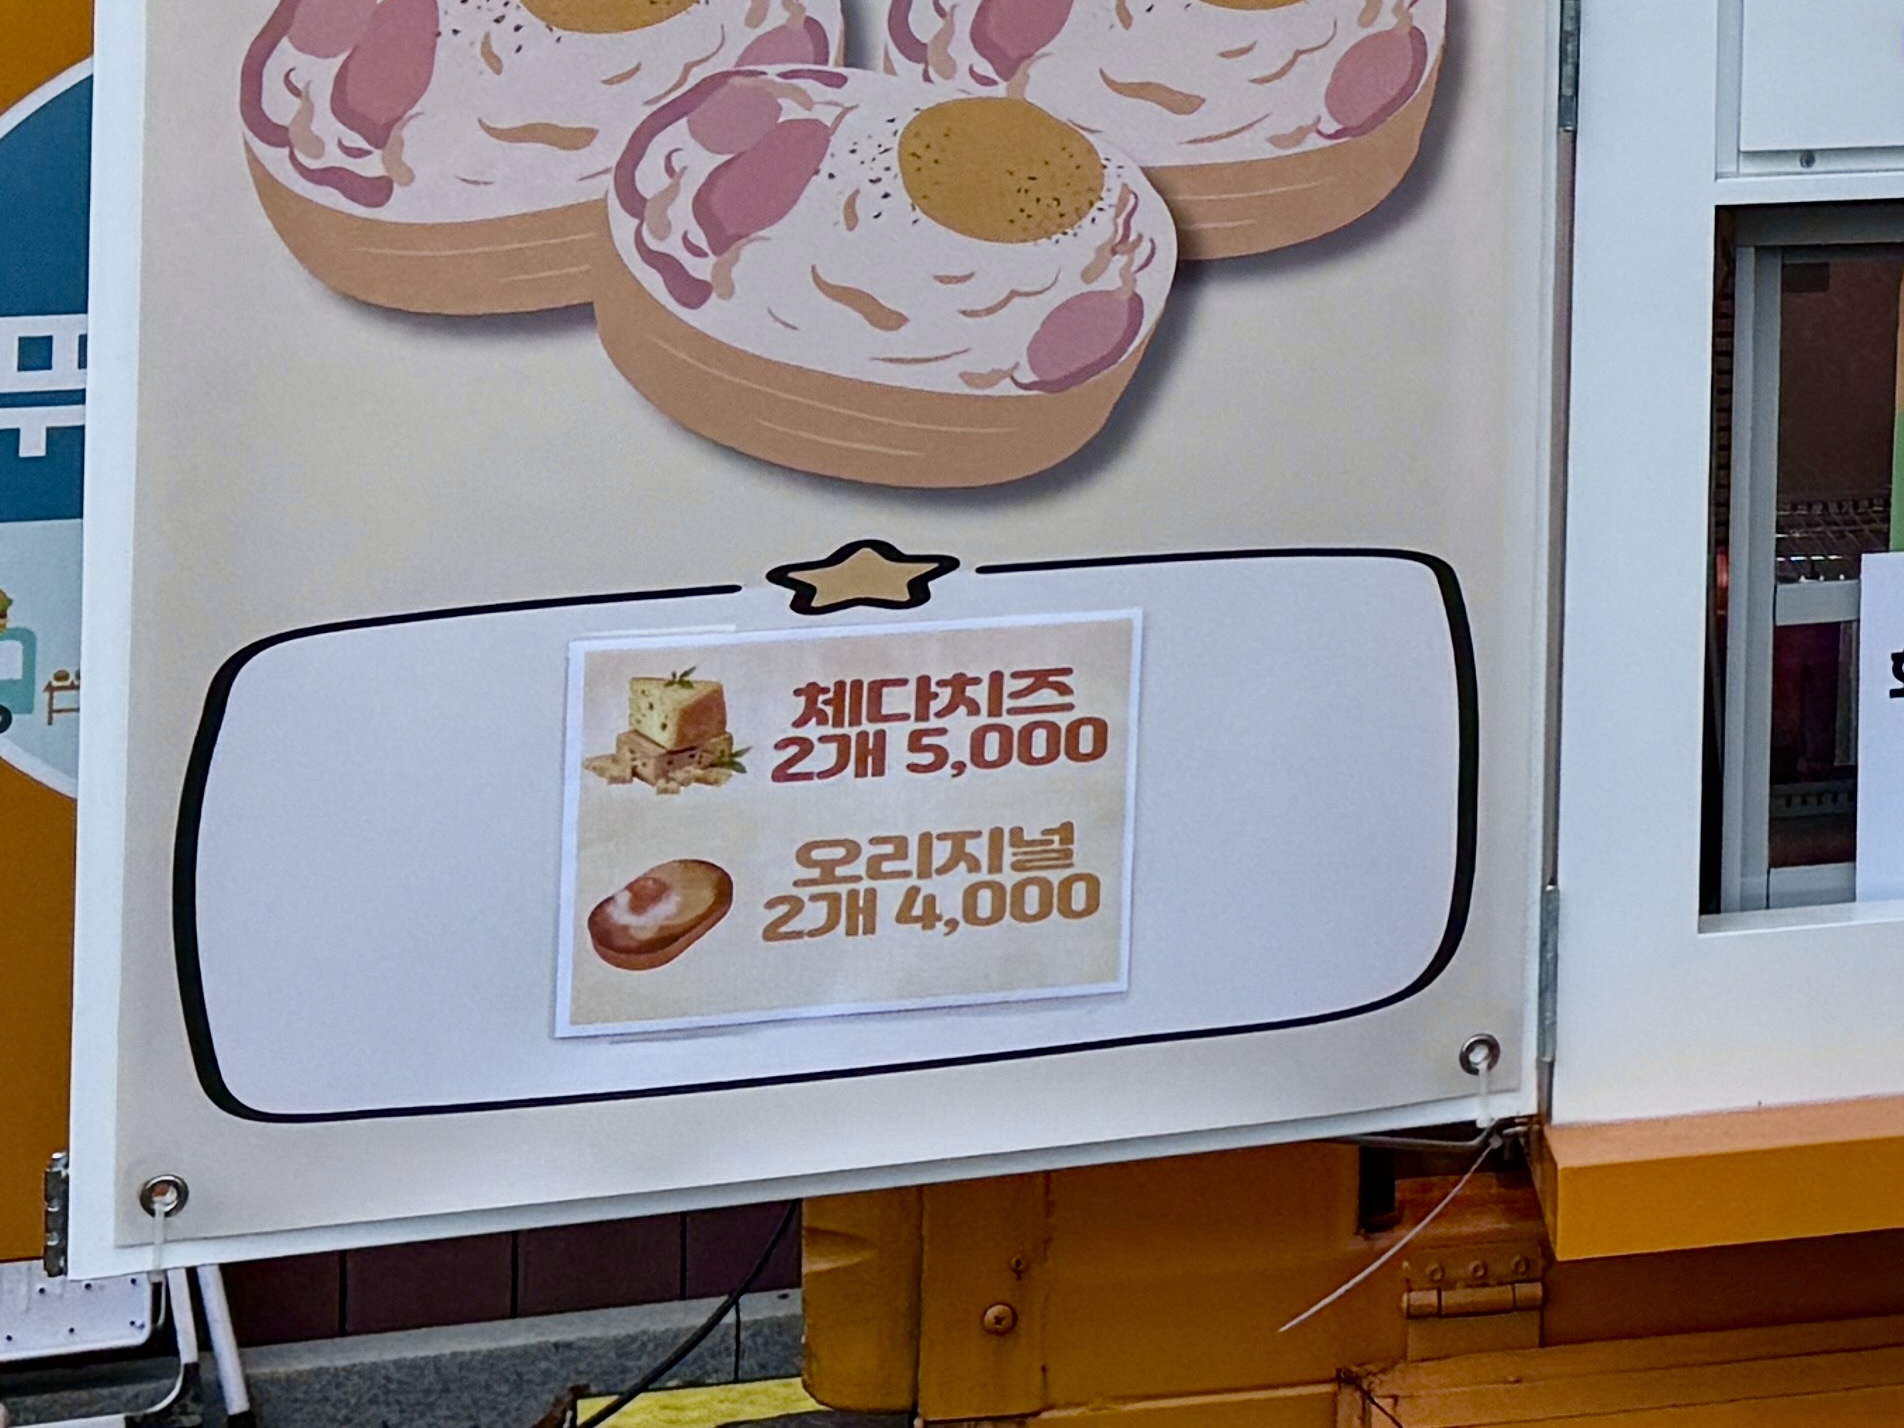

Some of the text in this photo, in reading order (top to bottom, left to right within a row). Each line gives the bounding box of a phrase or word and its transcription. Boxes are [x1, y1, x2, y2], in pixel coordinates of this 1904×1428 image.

[790, 666, 1076, 729] 체다치즈
[770, 716, 1109, 784] 2개 5,000
[791, 820, 1075, 888] 오리지널
[761, 872, 1101, 942] 2개 4,000
